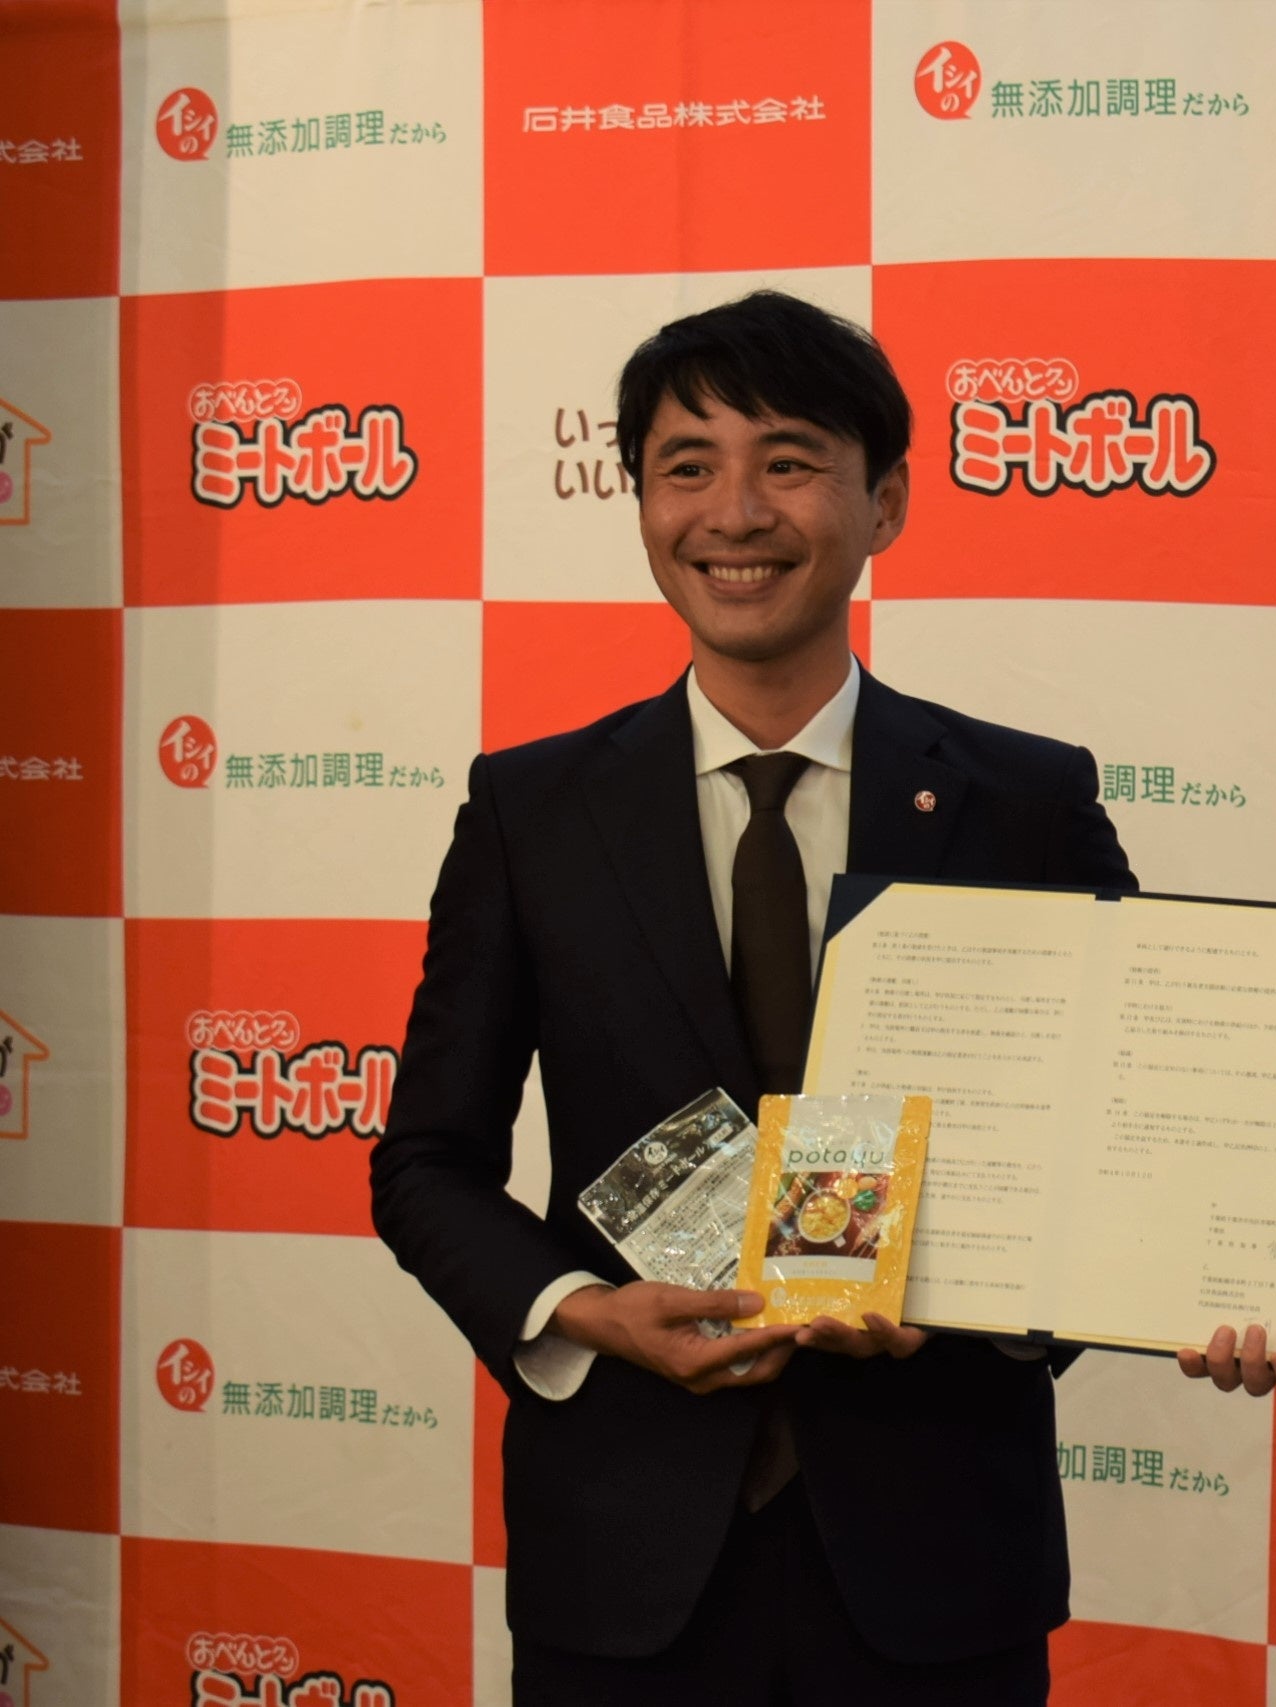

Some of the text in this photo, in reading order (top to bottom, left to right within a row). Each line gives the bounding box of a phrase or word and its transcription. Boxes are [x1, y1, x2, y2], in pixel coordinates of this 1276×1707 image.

[523, 94, 826, 133] 石井食品株式会社
[990, 78, 1251, 118] 無添加調理だから
[225, 108, 447, 159] 無添加調理だから
[191, 403, 418, 510] ミートボール
[949, 389, 1217, 498] ミートボール
[225, 752, 446, 789] 無添加調理だから
[1103, 763, 1247, 808] 調理だから
[221, 1380, 439, 1429] 無添加調理だから
